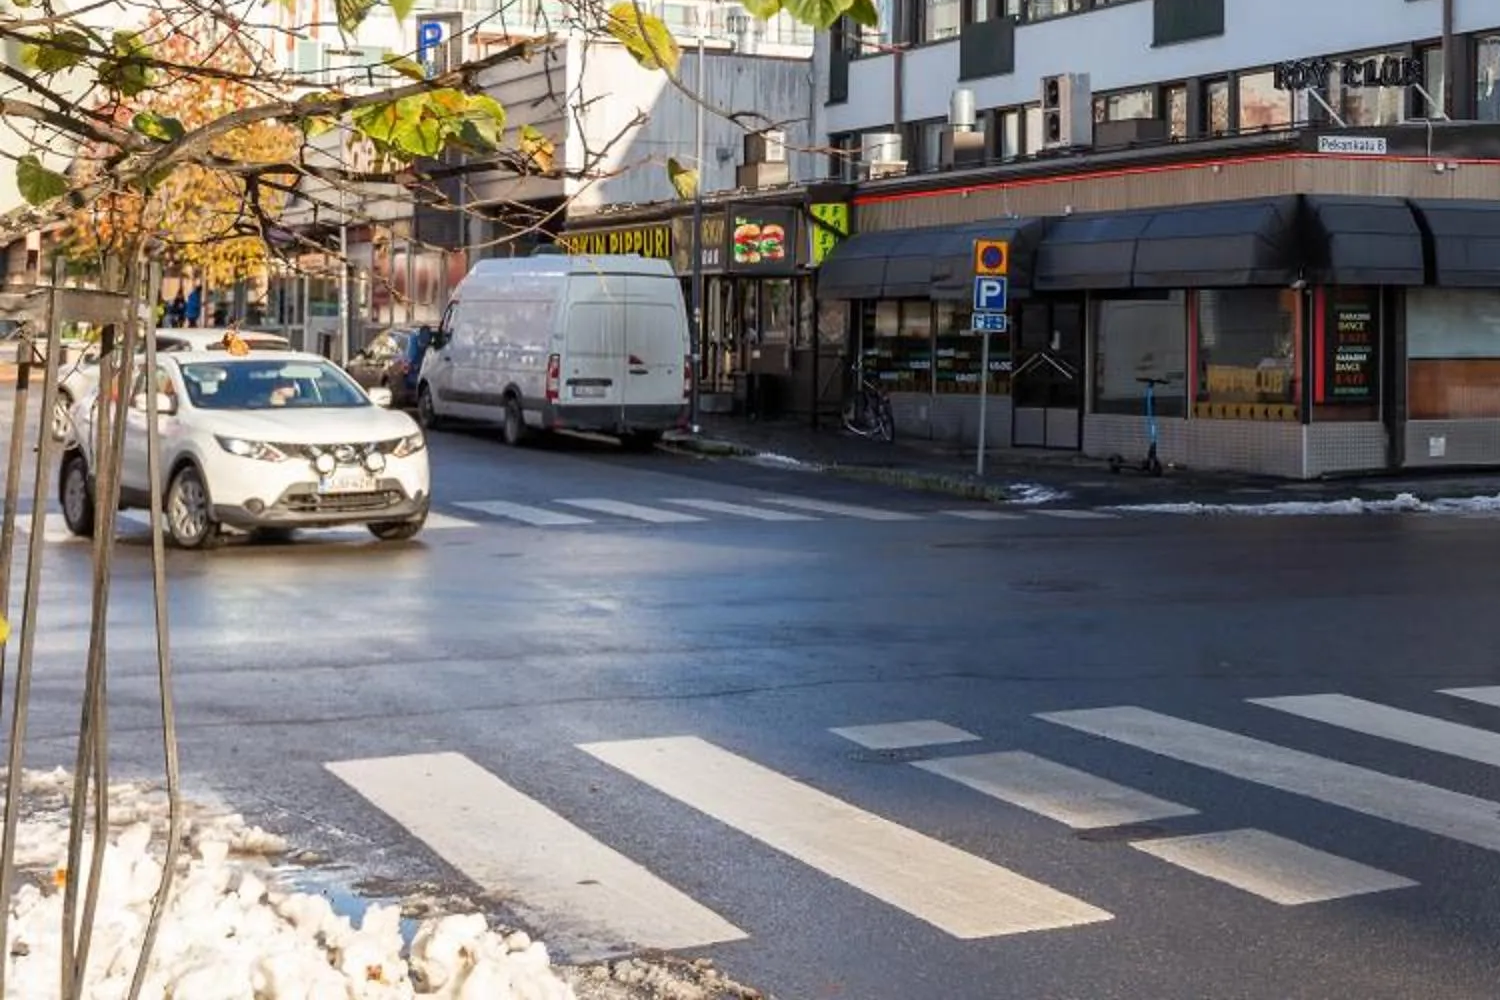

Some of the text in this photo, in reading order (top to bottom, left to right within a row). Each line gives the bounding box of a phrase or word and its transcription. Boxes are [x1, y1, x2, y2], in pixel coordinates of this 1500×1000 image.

[419, 23, 442, 61] P
[1343, 56, 1421, 87] CLUB
[1321, 137, 1374, 150] Pekankatu
[609, 226, 669, 257] PIPPURI
[819, 205, 829, 256] FST
[980, 280, 1001, 307] P
